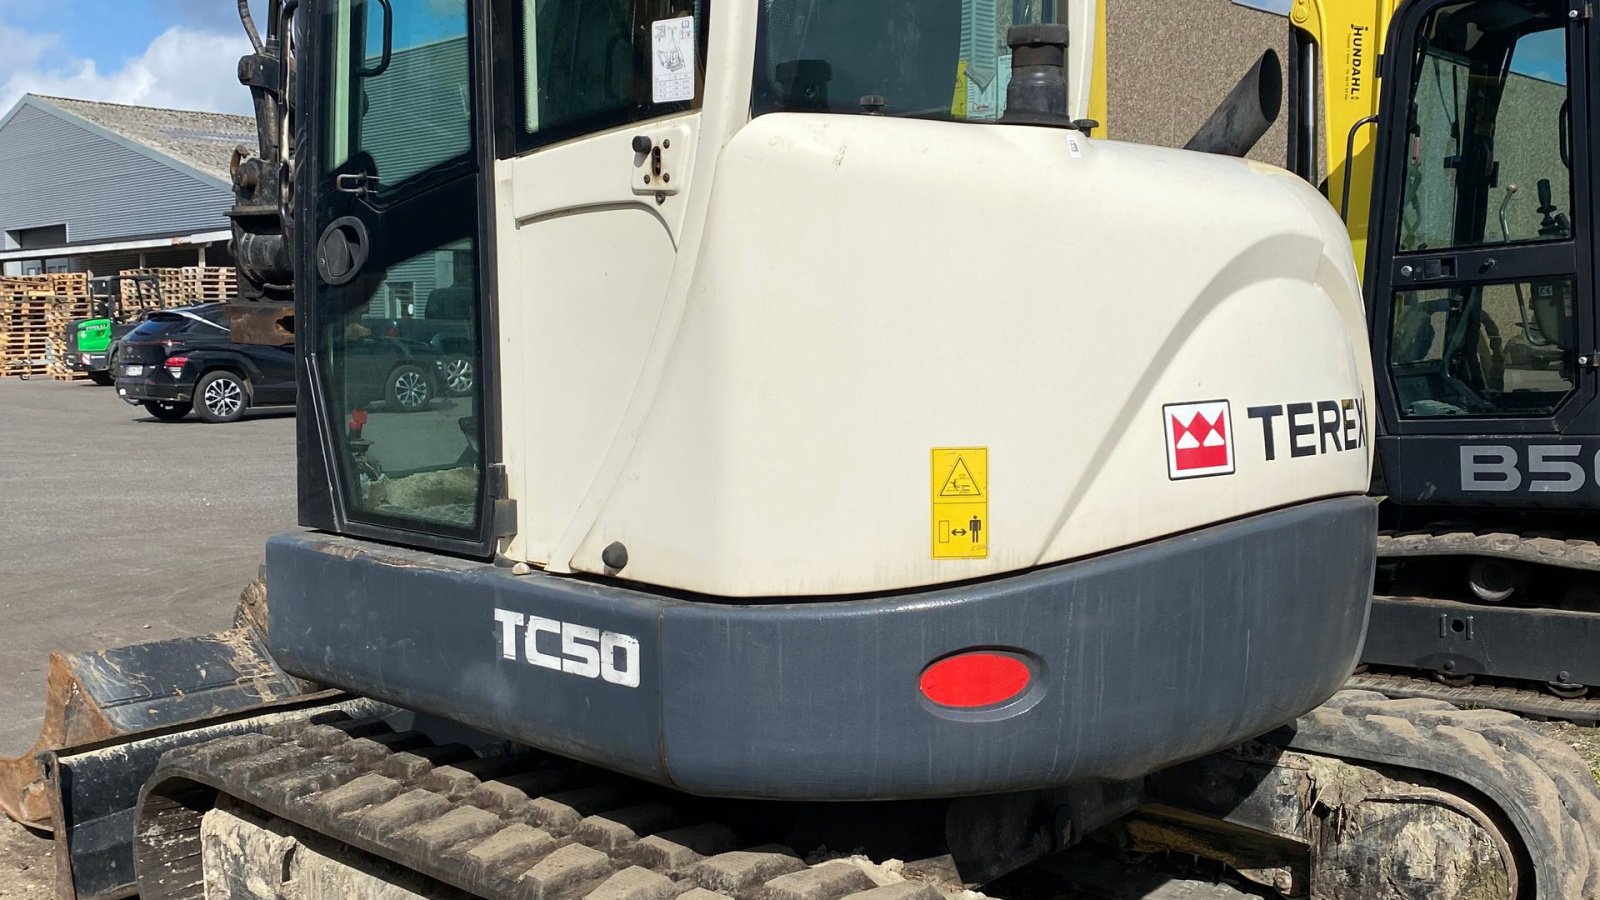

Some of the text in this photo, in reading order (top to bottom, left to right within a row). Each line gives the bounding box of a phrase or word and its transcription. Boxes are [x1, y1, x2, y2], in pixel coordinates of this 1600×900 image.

[1247, 398, 1366, 461] TEREX
[1460, 444, 1600, 493] B5
[494, 608, 640, 688] TC50
